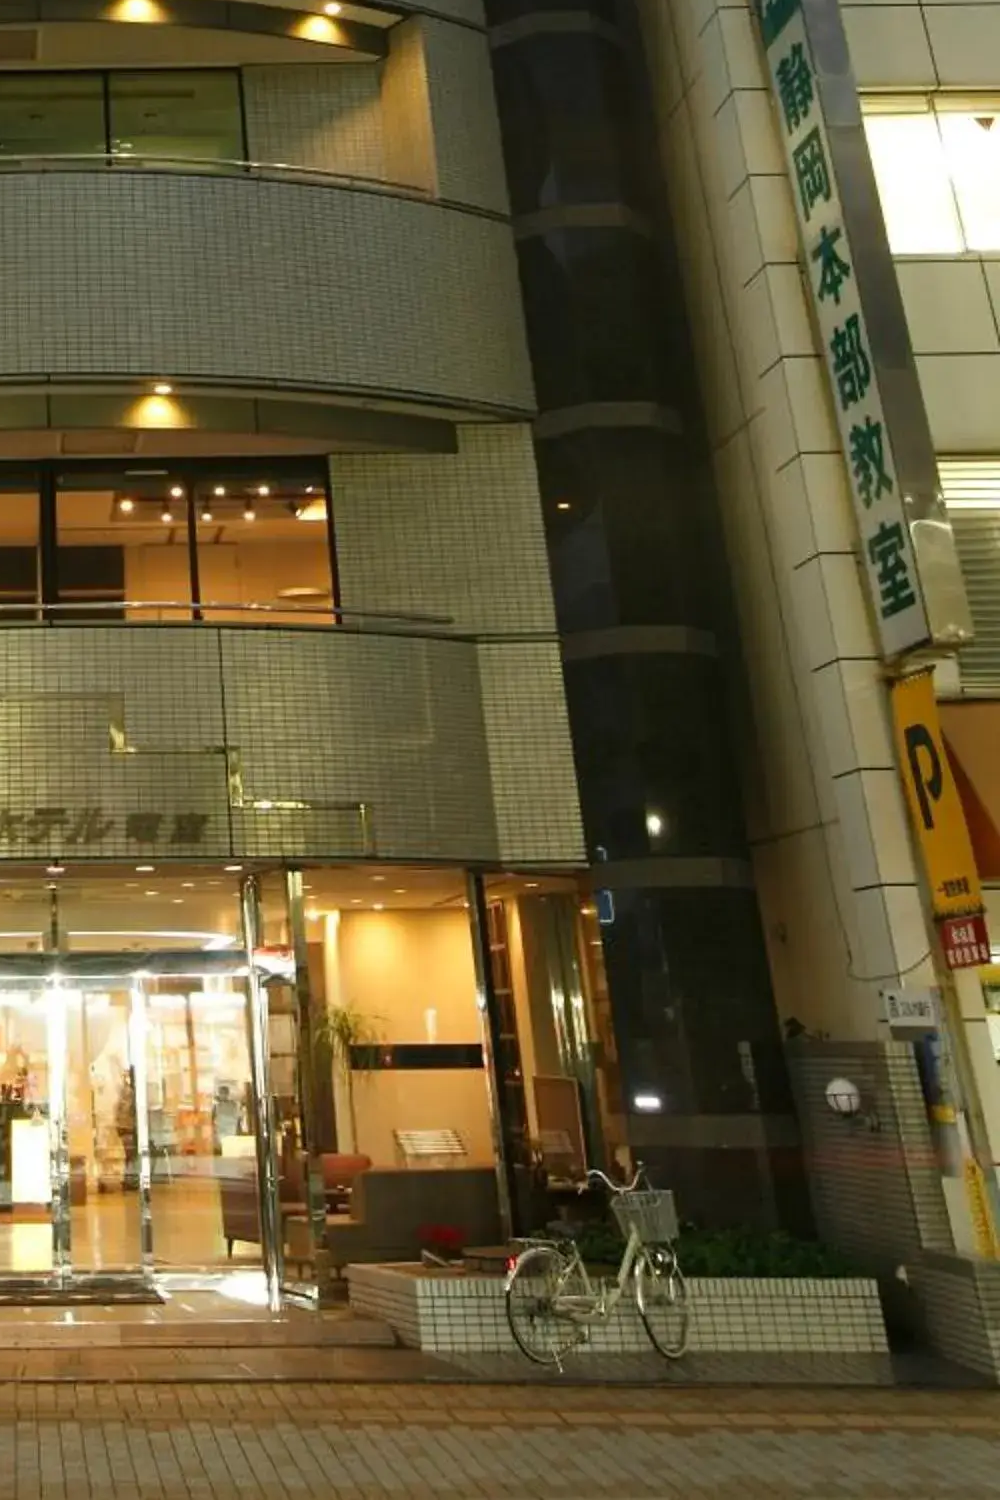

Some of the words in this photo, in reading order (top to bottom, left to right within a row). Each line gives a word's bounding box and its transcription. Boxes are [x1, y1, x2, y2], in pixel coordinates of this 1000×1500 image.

[775, 38, 915, 621] 静岡本部教室
[904, 723, 943, 831] P
